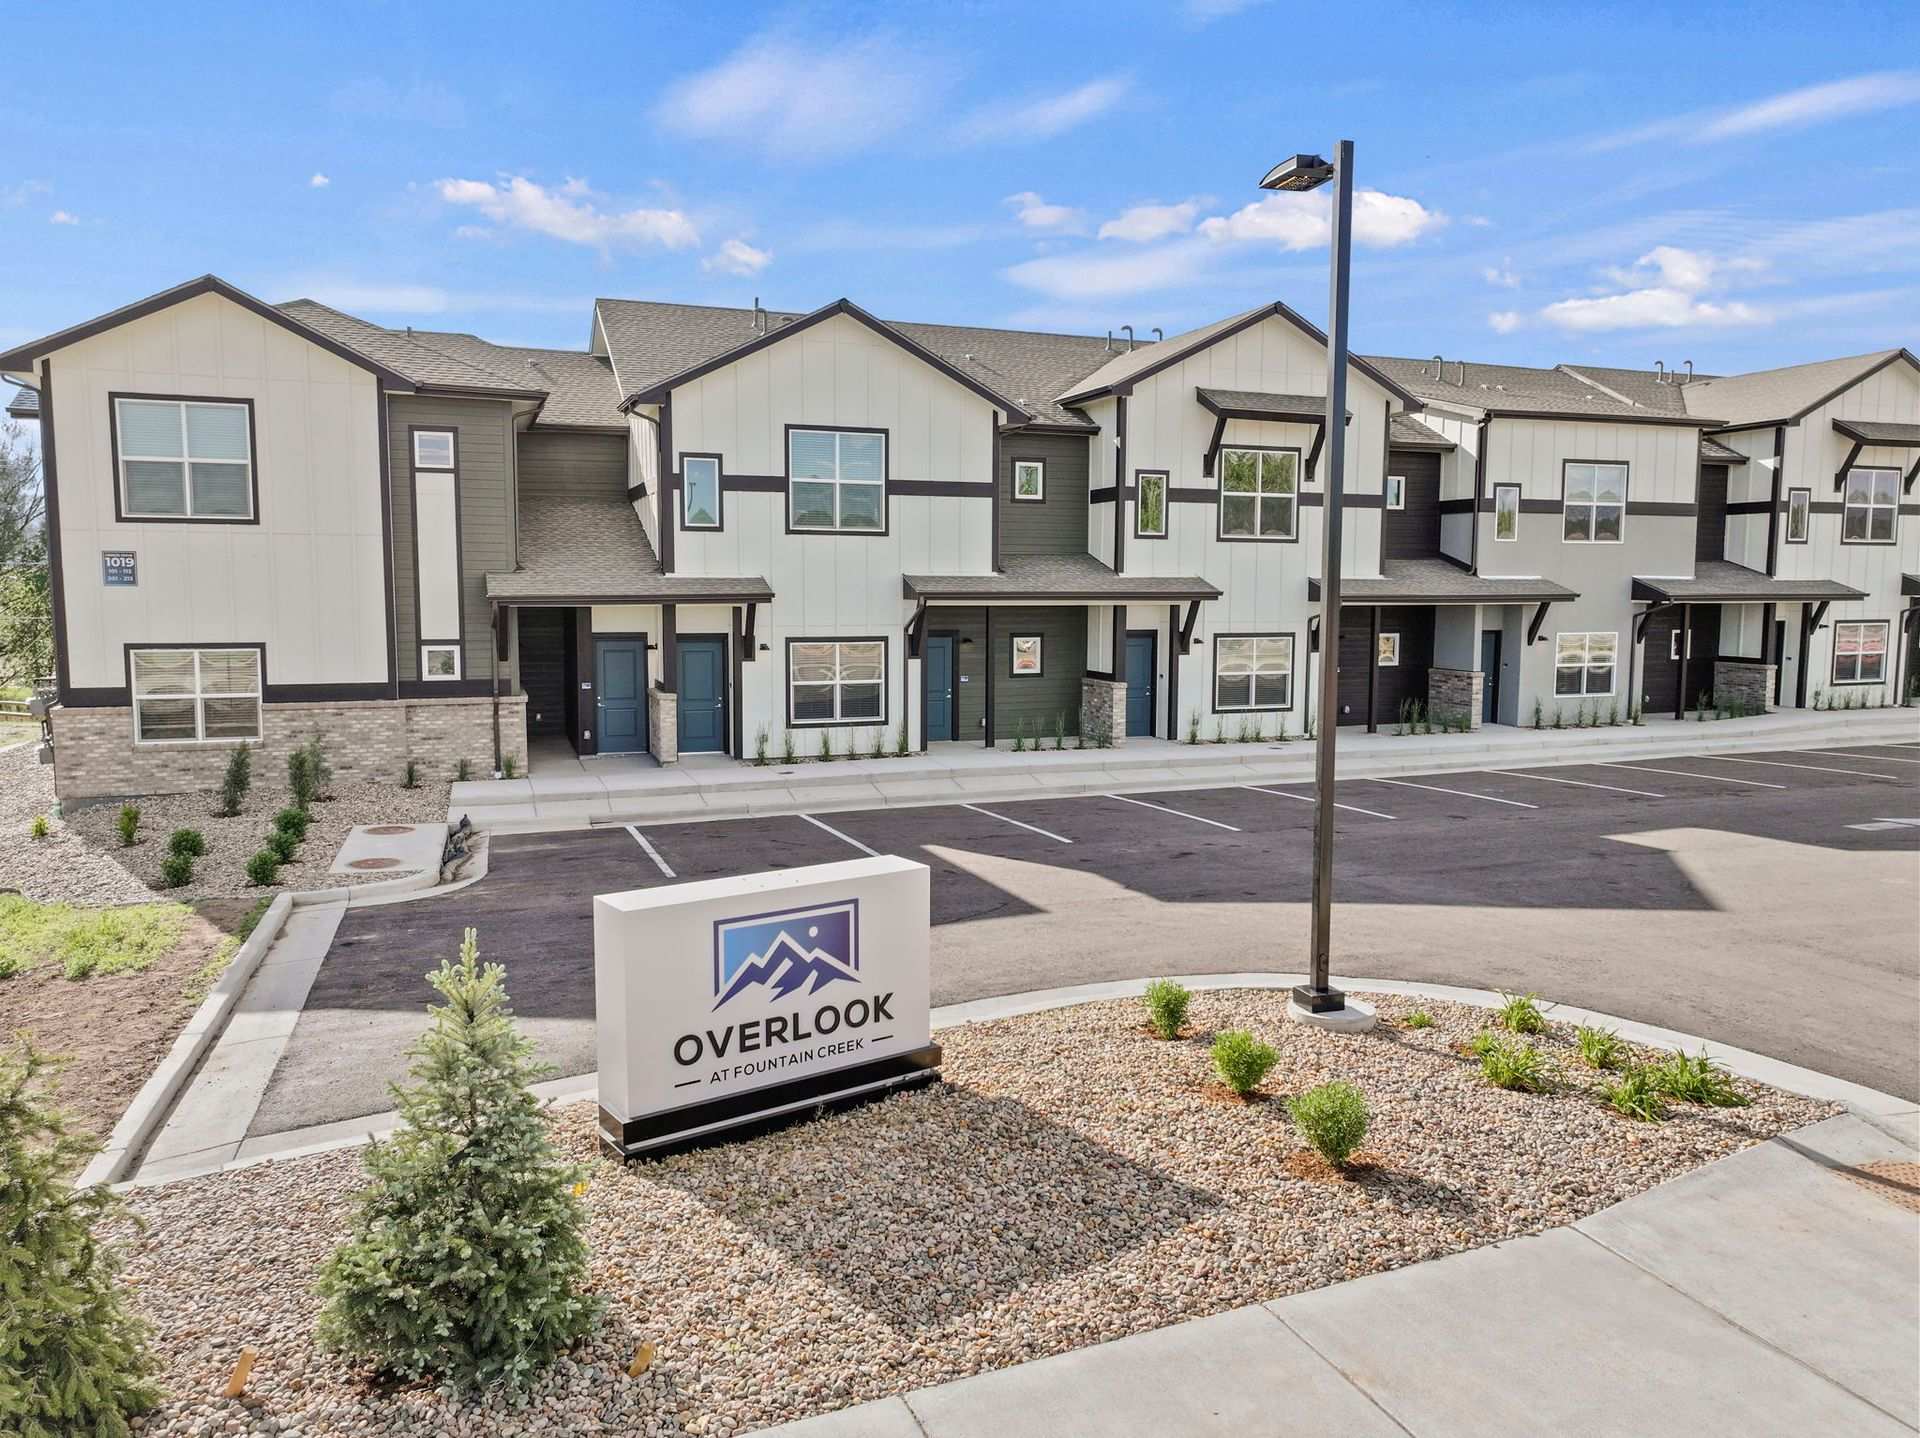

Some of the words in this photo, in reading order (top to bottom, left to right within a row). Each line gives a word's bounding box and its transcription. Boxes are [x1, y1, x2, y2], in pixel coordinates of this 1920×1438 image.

[105, 557, 134, 567] 1019
[674, 992, 894, 1066] OVERLOOK
[711, 1069, 730, 1083] AT
[734, 1050, 813, 1078] FOUNTAIN
[818, 1038, 864, 1058] CREEK
